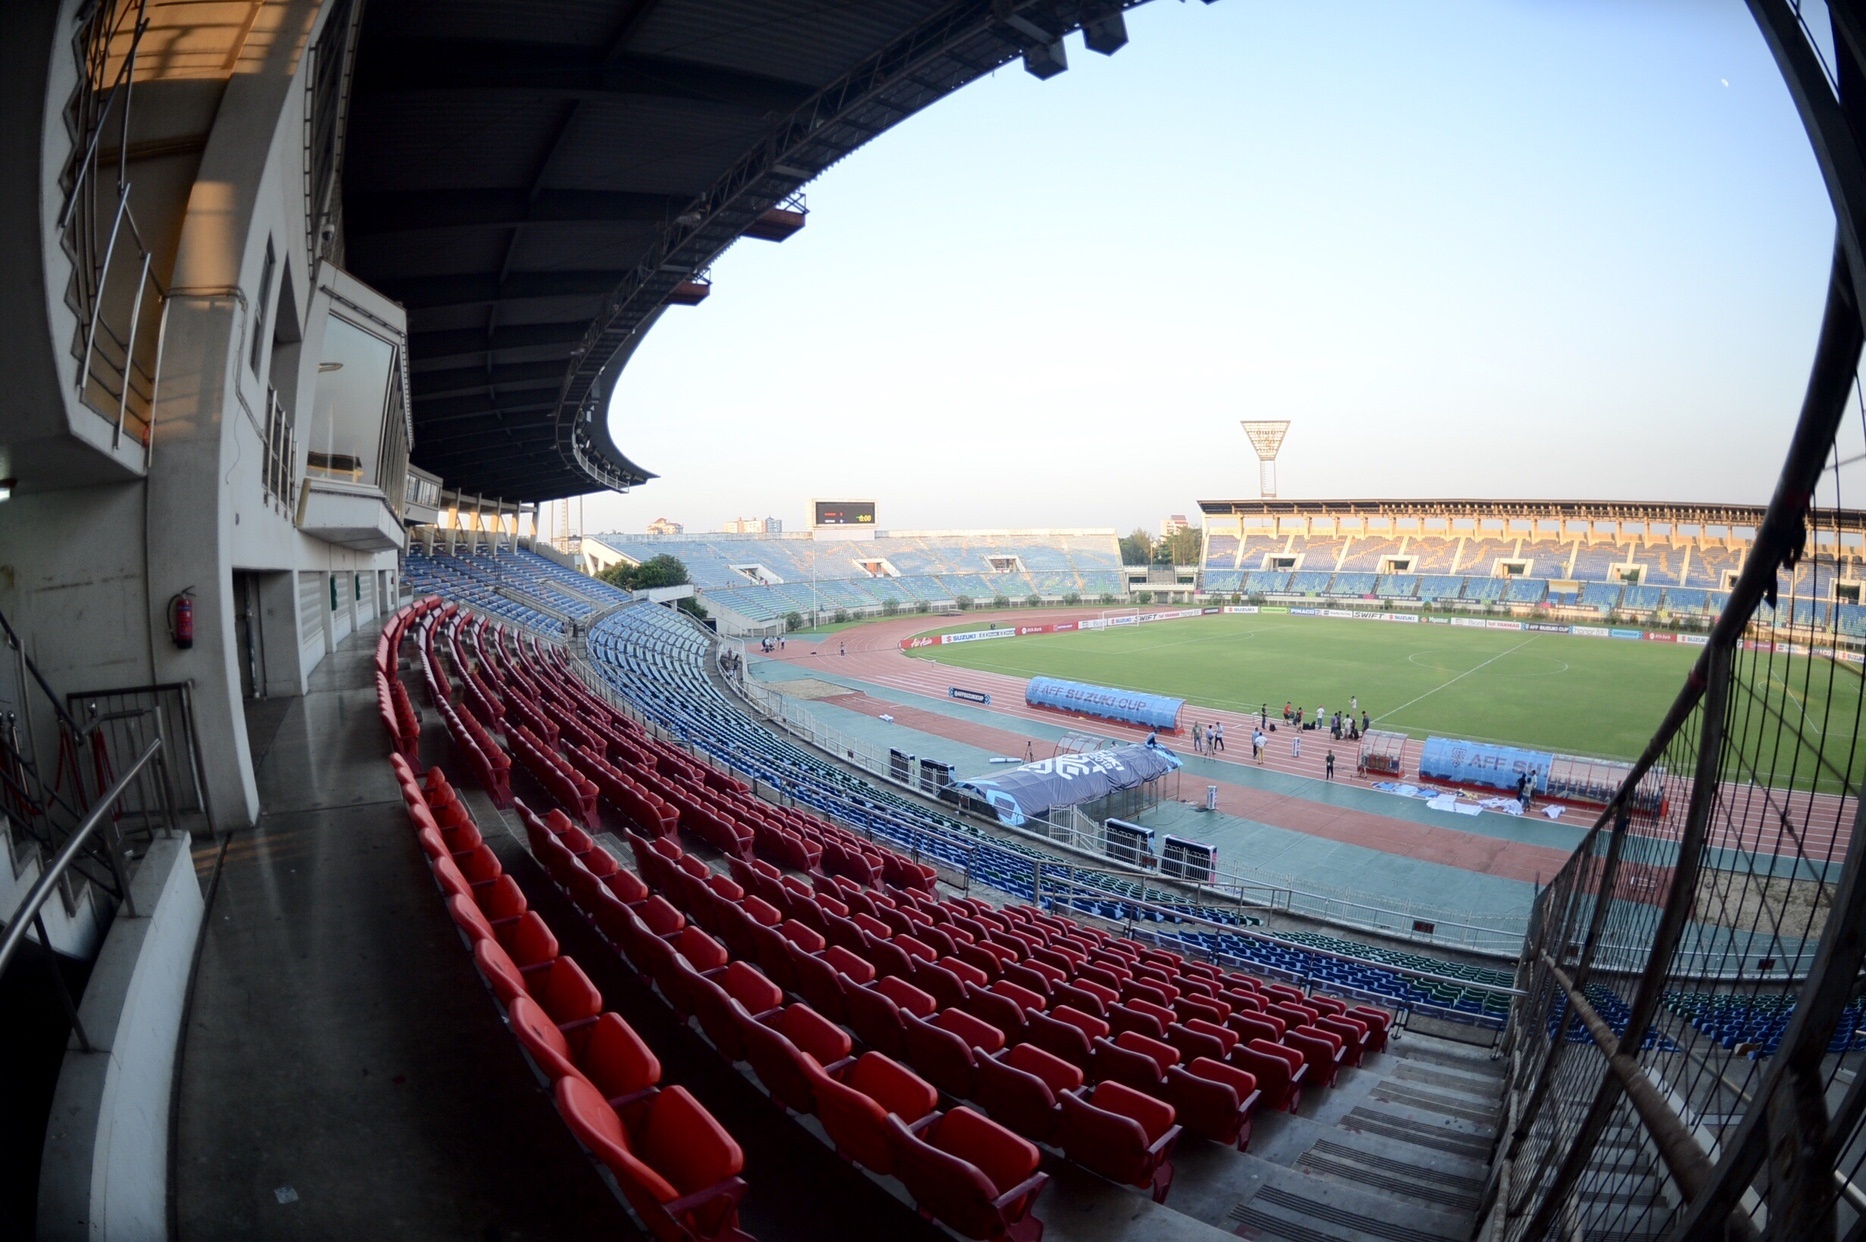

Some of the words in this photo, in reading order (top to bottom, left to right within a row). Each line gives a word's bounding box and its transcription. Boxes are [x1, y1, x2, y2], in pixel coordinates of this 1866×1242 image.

[953, 633, 976, 641] SUZUKI
[1041, 685, 1064, 697] AFF
[1065, 688, 1116, 707] SUZUKI
[1118, 698, 1147, 711] CUP
[1468, 753, 1506, 770] AFF
